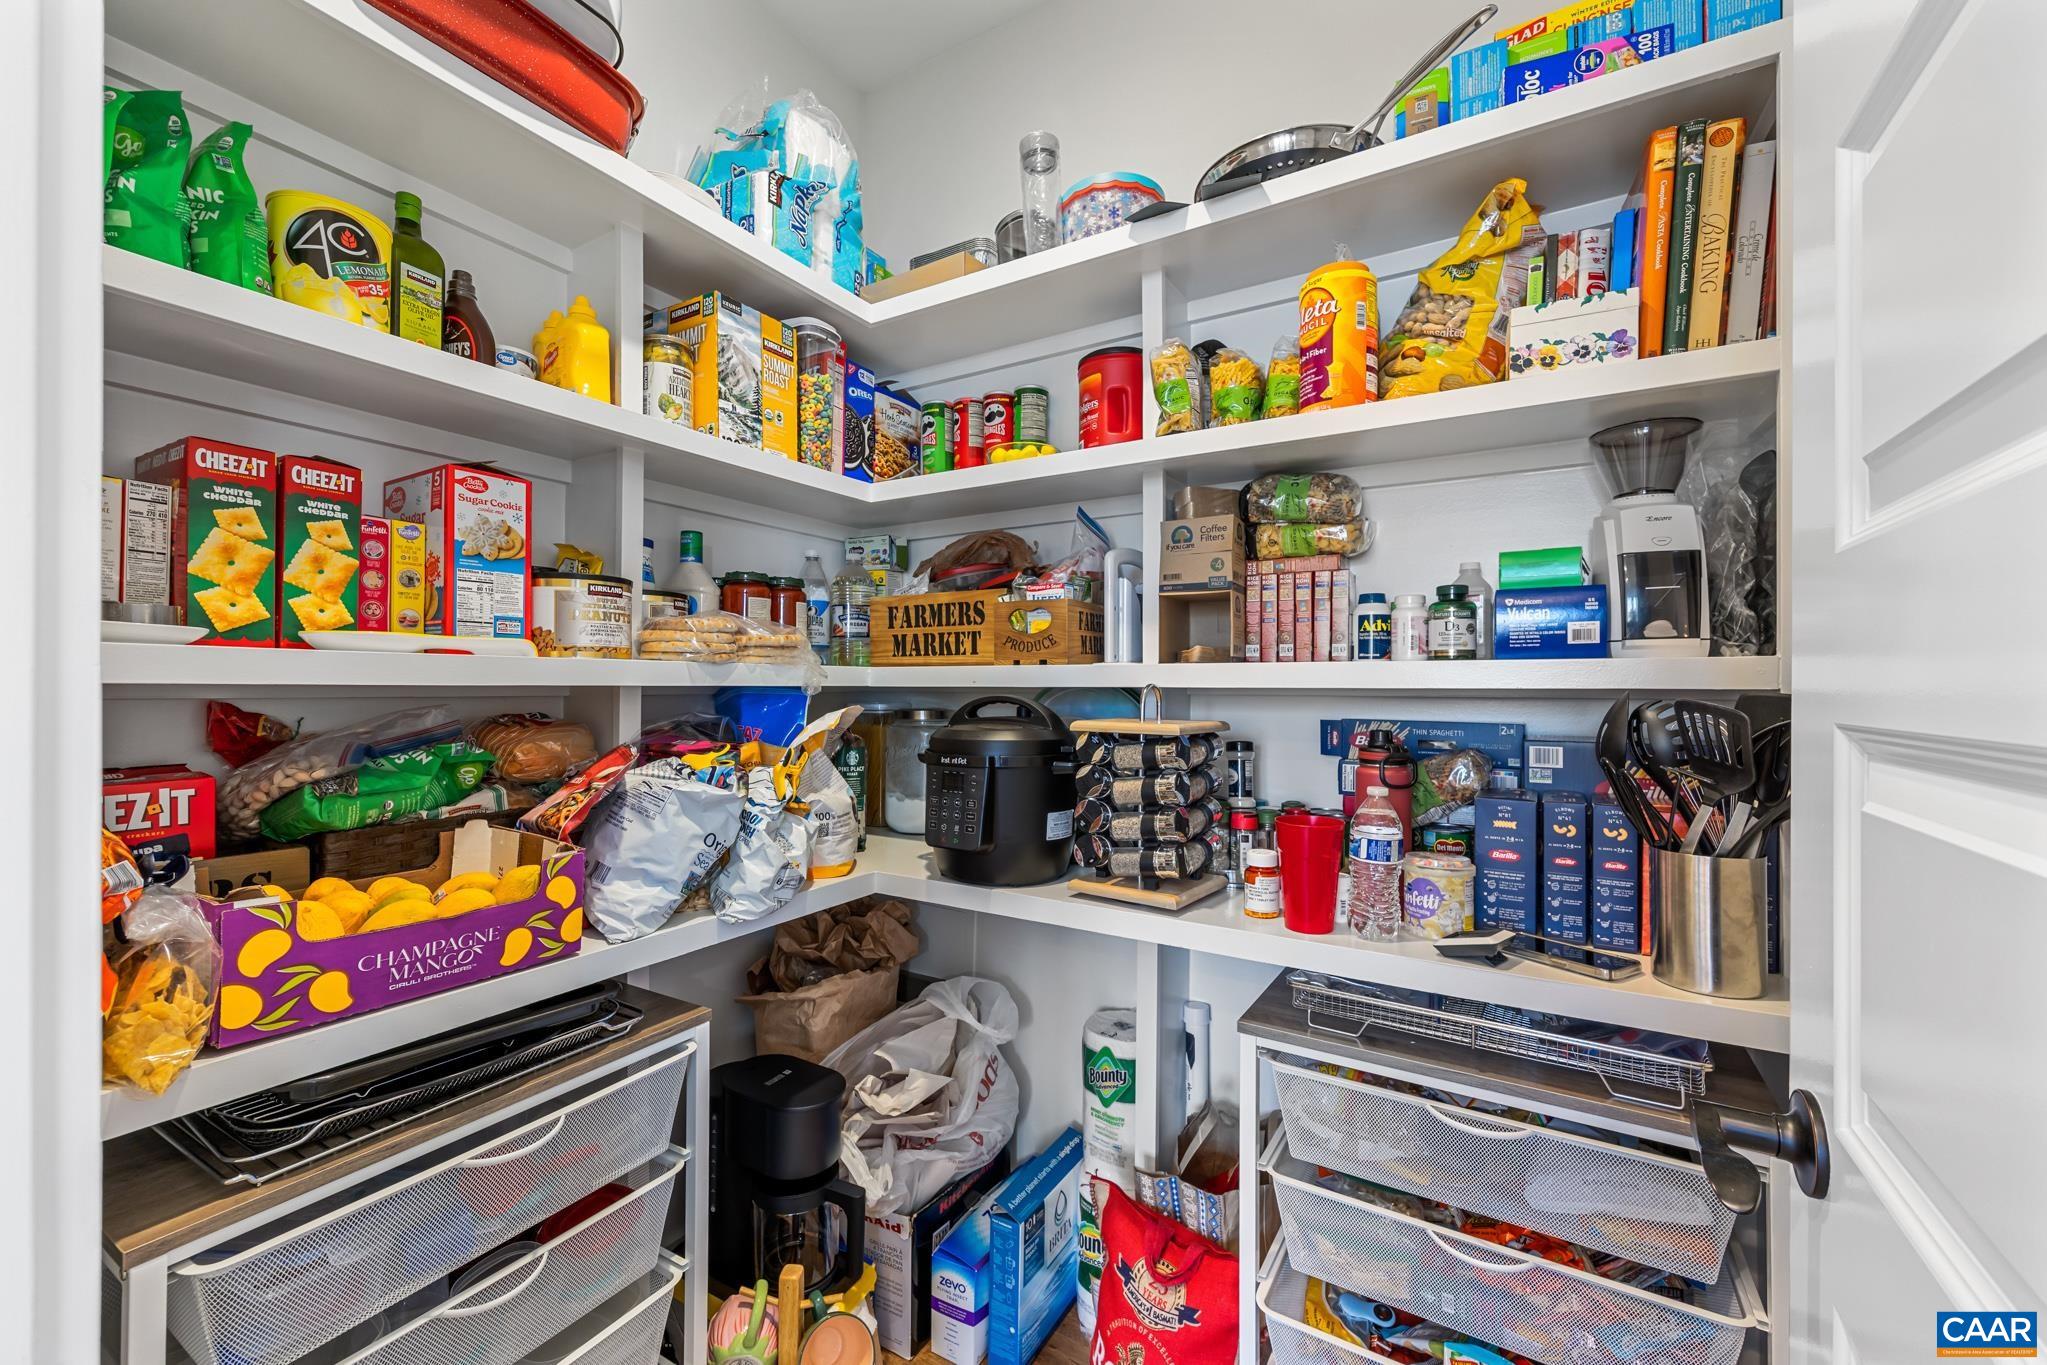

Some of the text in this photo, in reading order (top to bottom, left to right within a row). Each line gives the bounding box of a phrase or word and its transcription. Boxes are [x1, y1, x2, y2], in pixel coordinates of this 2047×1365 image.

[1571, 5, 1598, 16] WINTER
[1679, 172, 1696, 294] Complete ENTERTAINING Cookbook
[292, 218, 368, 279] 4C
[1699, 213, 1728, 294] BAKING
[367, 283, 384, 296] 35
[703, 296, 714, 306] 120
[722, 299, 742, 314] KEURIG
[671, 302, 700, 318] KIRKLAND
[782, 327, 793, 337] 120
[1423, 327, 1466, 339] unsalted
[763, 339, 793, 358] KIRKLAND
[1309, 346, 1327, 359] Fiber
[763, 353, 795, 379] SUMMIT
[763, 369, 790, 390] ROAST
[848, 387, 873, 401] OREO
[433, 470, 441, 487] 5
[458, 493, 489, 507] Sugar
[1200, 524, 1228, 534] Coffee
[1200, 533, 1225, 543] Filters
[1171, 544, 1181, 552] you
[590, 584, 623, 595] KIRKLAND
[887, 600, 986, 630] FARMERS
[1507, 606, 1551, 620] Vulcan
[1444, 620, 1460, 632] D3
[891, 630, 982, 658] MARKET
[1003, 633, 1057, 653] PRODUCE
[1412, 728, 1464, 737] THIN SPAGHETTI
[1491, 850, 1518, 860] Barilla
[1554, 857, 1577, 866] Barilla
[1604, 861, 1627, 870] Barilla
[357, 927, 501, 973] CHAMPAGNE
[389, 948, 476, 984] MANGO
[389, 977, 421, 991] CIRULI
[1088, 1066, 1128, 1086] Bounty
[1013, 1191, 1027, 1208] better
[1025, 1177, 1041, 1195] planet
[1038, 1167, 1051, 1181] starts
[1048, 1218, 1072, 1252] BRITA
[939, 1275, 967, 1294] zevo
[1127, 1286, 1147, 1312] AMERICA'S
[1142, 1287, 1168, 1309] YEARS
[1109, 1318, 1137, 1335] TRADITION
[1138, 1325, 1148, 1338] OF
